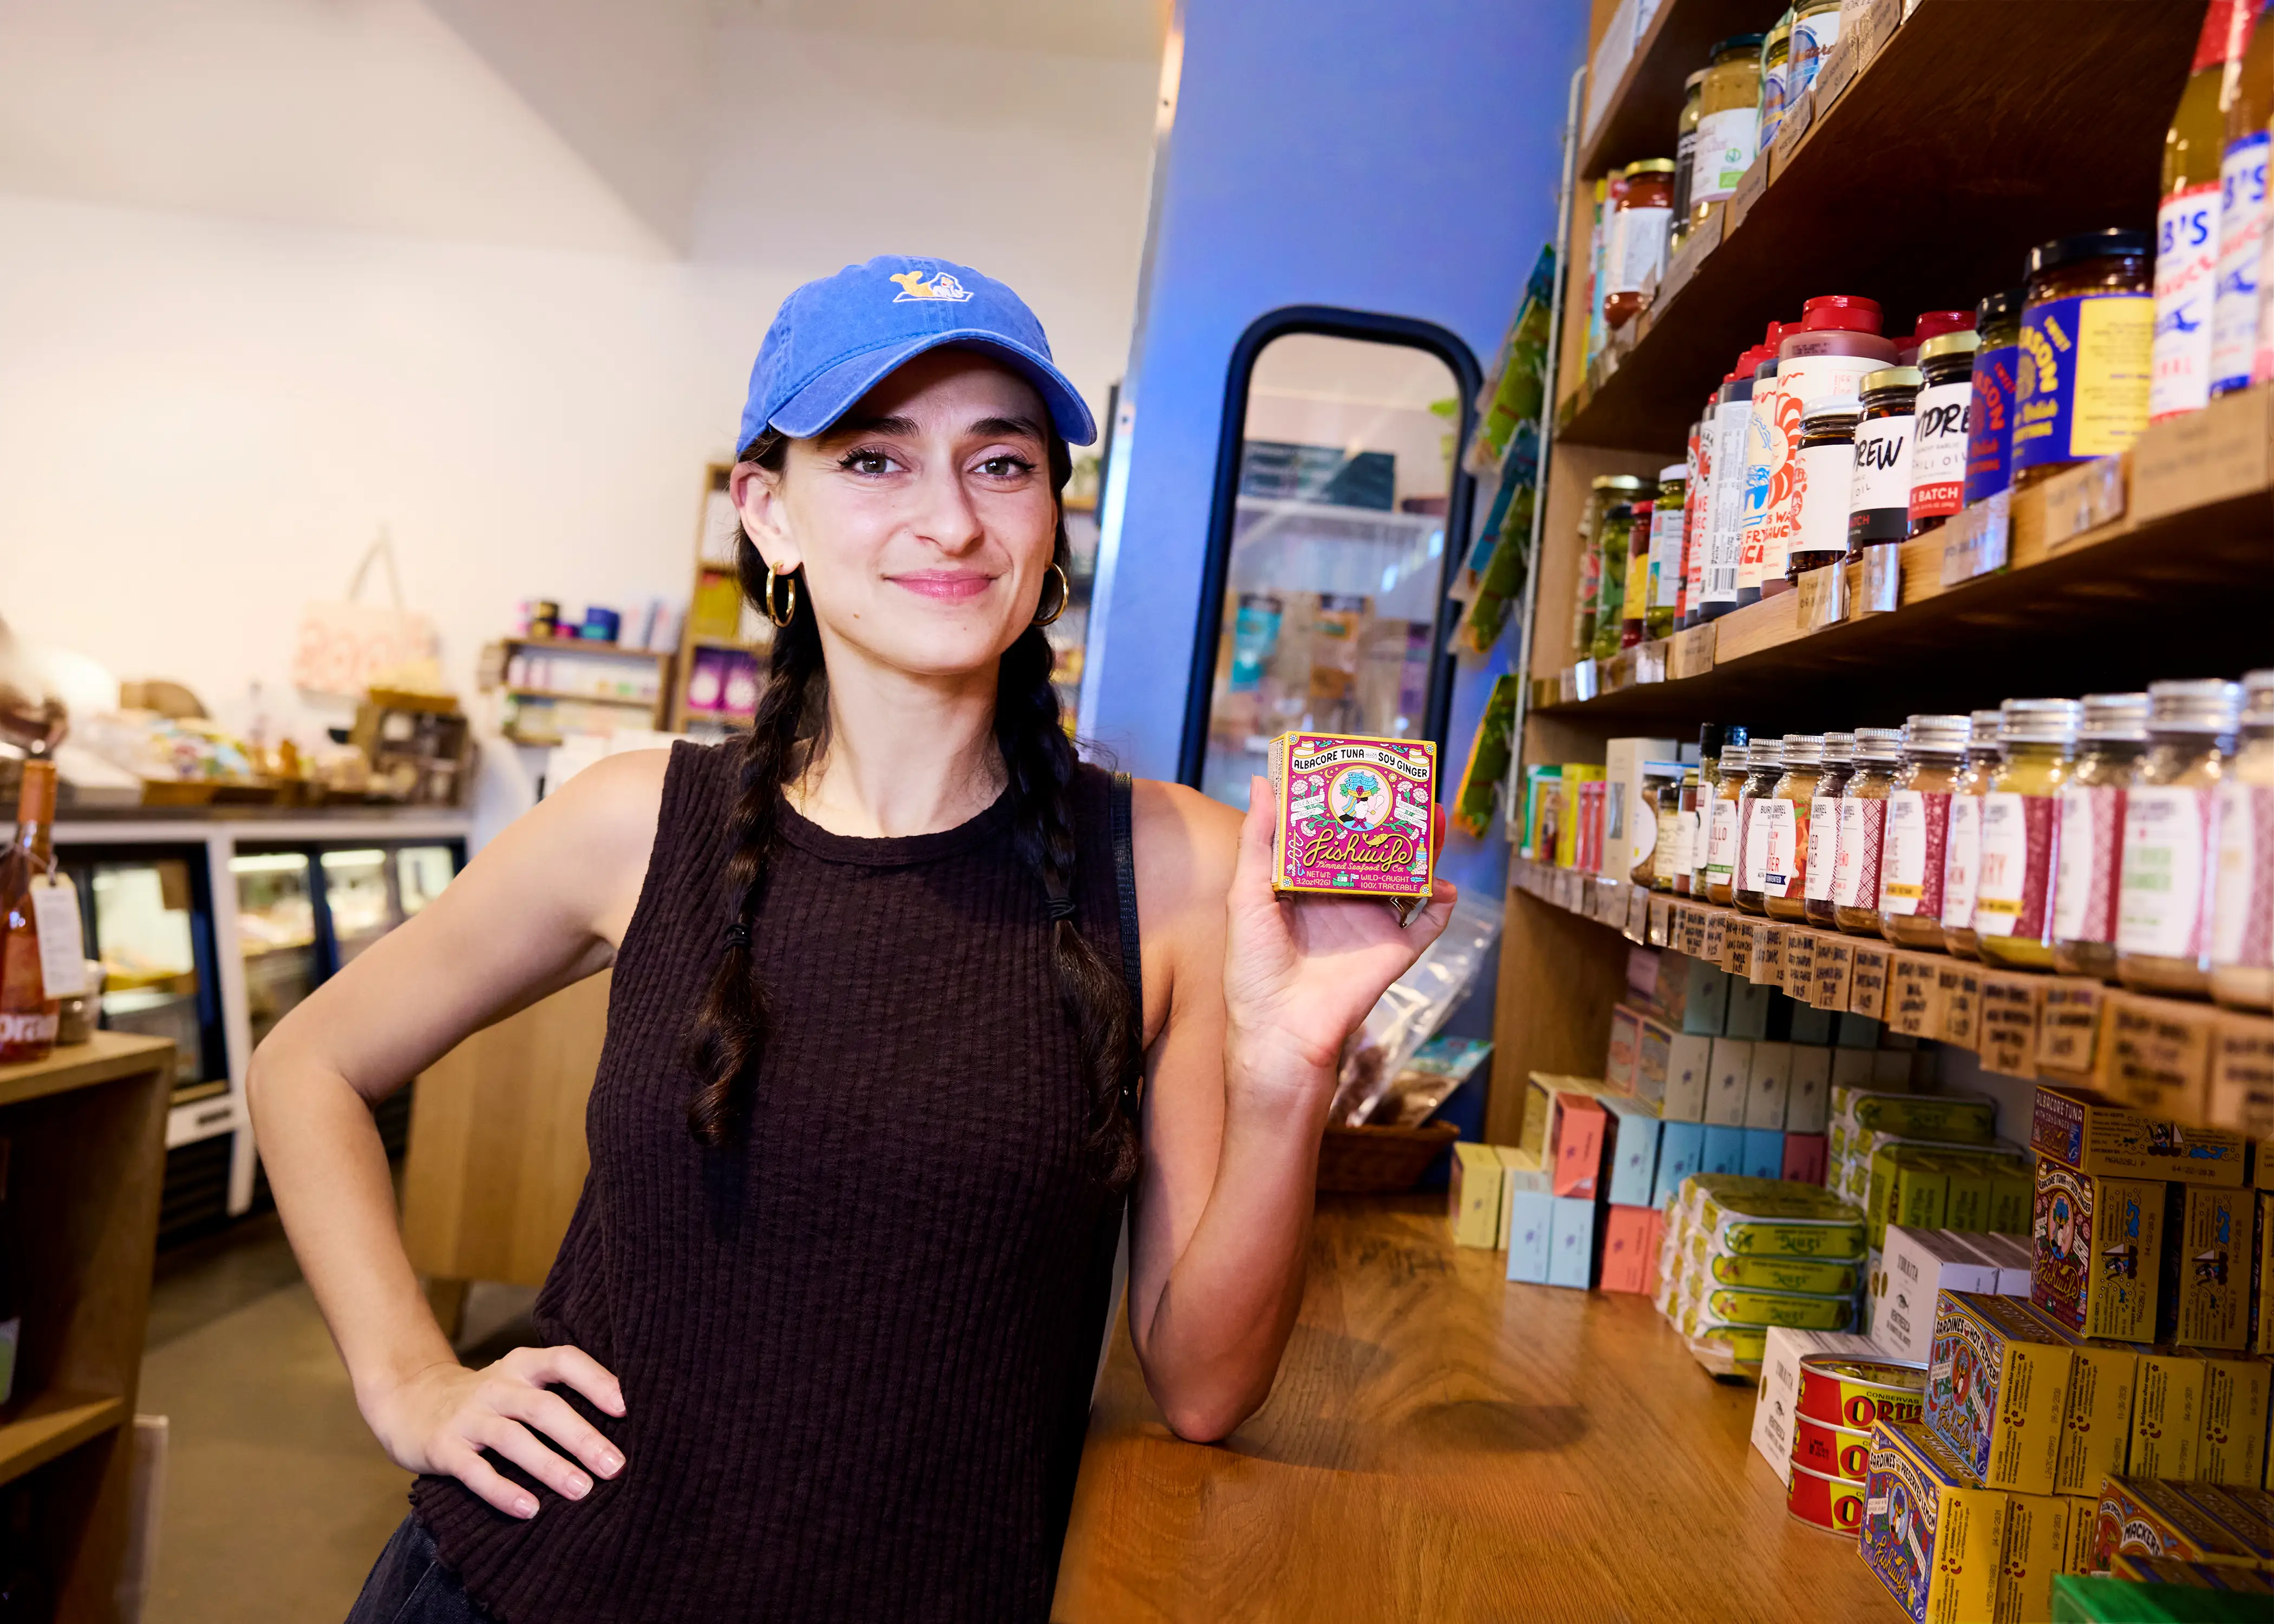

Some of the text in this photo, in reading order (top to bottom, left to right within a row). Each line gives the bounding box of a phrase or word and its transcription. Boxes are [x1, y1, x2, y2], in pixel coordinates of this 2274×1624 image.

[1919, 487, 1959, 502] BATCH
[1294, 750, 1337, 769] ALBACORE
[1341, 749, 1364, 758] TUNA
[1378, 752, 1395, 765] SOY
[1397, 760, 1428, 778] GINGER
[1293, 800, 1305, 808] POLE
[1310, 796, 1322, 804] LINE
[1396, 800, 1427, 816] FRESHLY GROUND
[1296, 809, 1316, 818] CAUGHT
[1395, 812, 1409, 820] GINGER
[1412, 818, 1426, 827] GARLIC
[1303, 829, 1414, 872] Fishwife
[1315, 861, 1346, 871] Tinned
[1348, 863, 1380, 872] Seafood
[1361, 874, 1409, 882] WILD-CAUGHT
[1378, 882, 1417, 891] TRACEABLE
[2036, 1092, 2082, 1123] ALBACORE TUNA
[2038, 1175, 2055, 1188] ALBACORE
[2056, 1174, 2066, 1184] TUNA
[2036, 1252, 2079, 1304] Fishwife
[1936, 1316, 1996, 1382] SARDINES HOT PEPPER
[1866, 1391, 1919, 1404] CONSERVAS
[2004, 1385, 2012, 1414] Refrigerate
[1936, 1398, 1972, 1453] Fishwife
[1869, 1452, 1936, 1528] SARDINES PRESERVED LEMON
[1874, 1535, 1910, 1595] Fishwife
